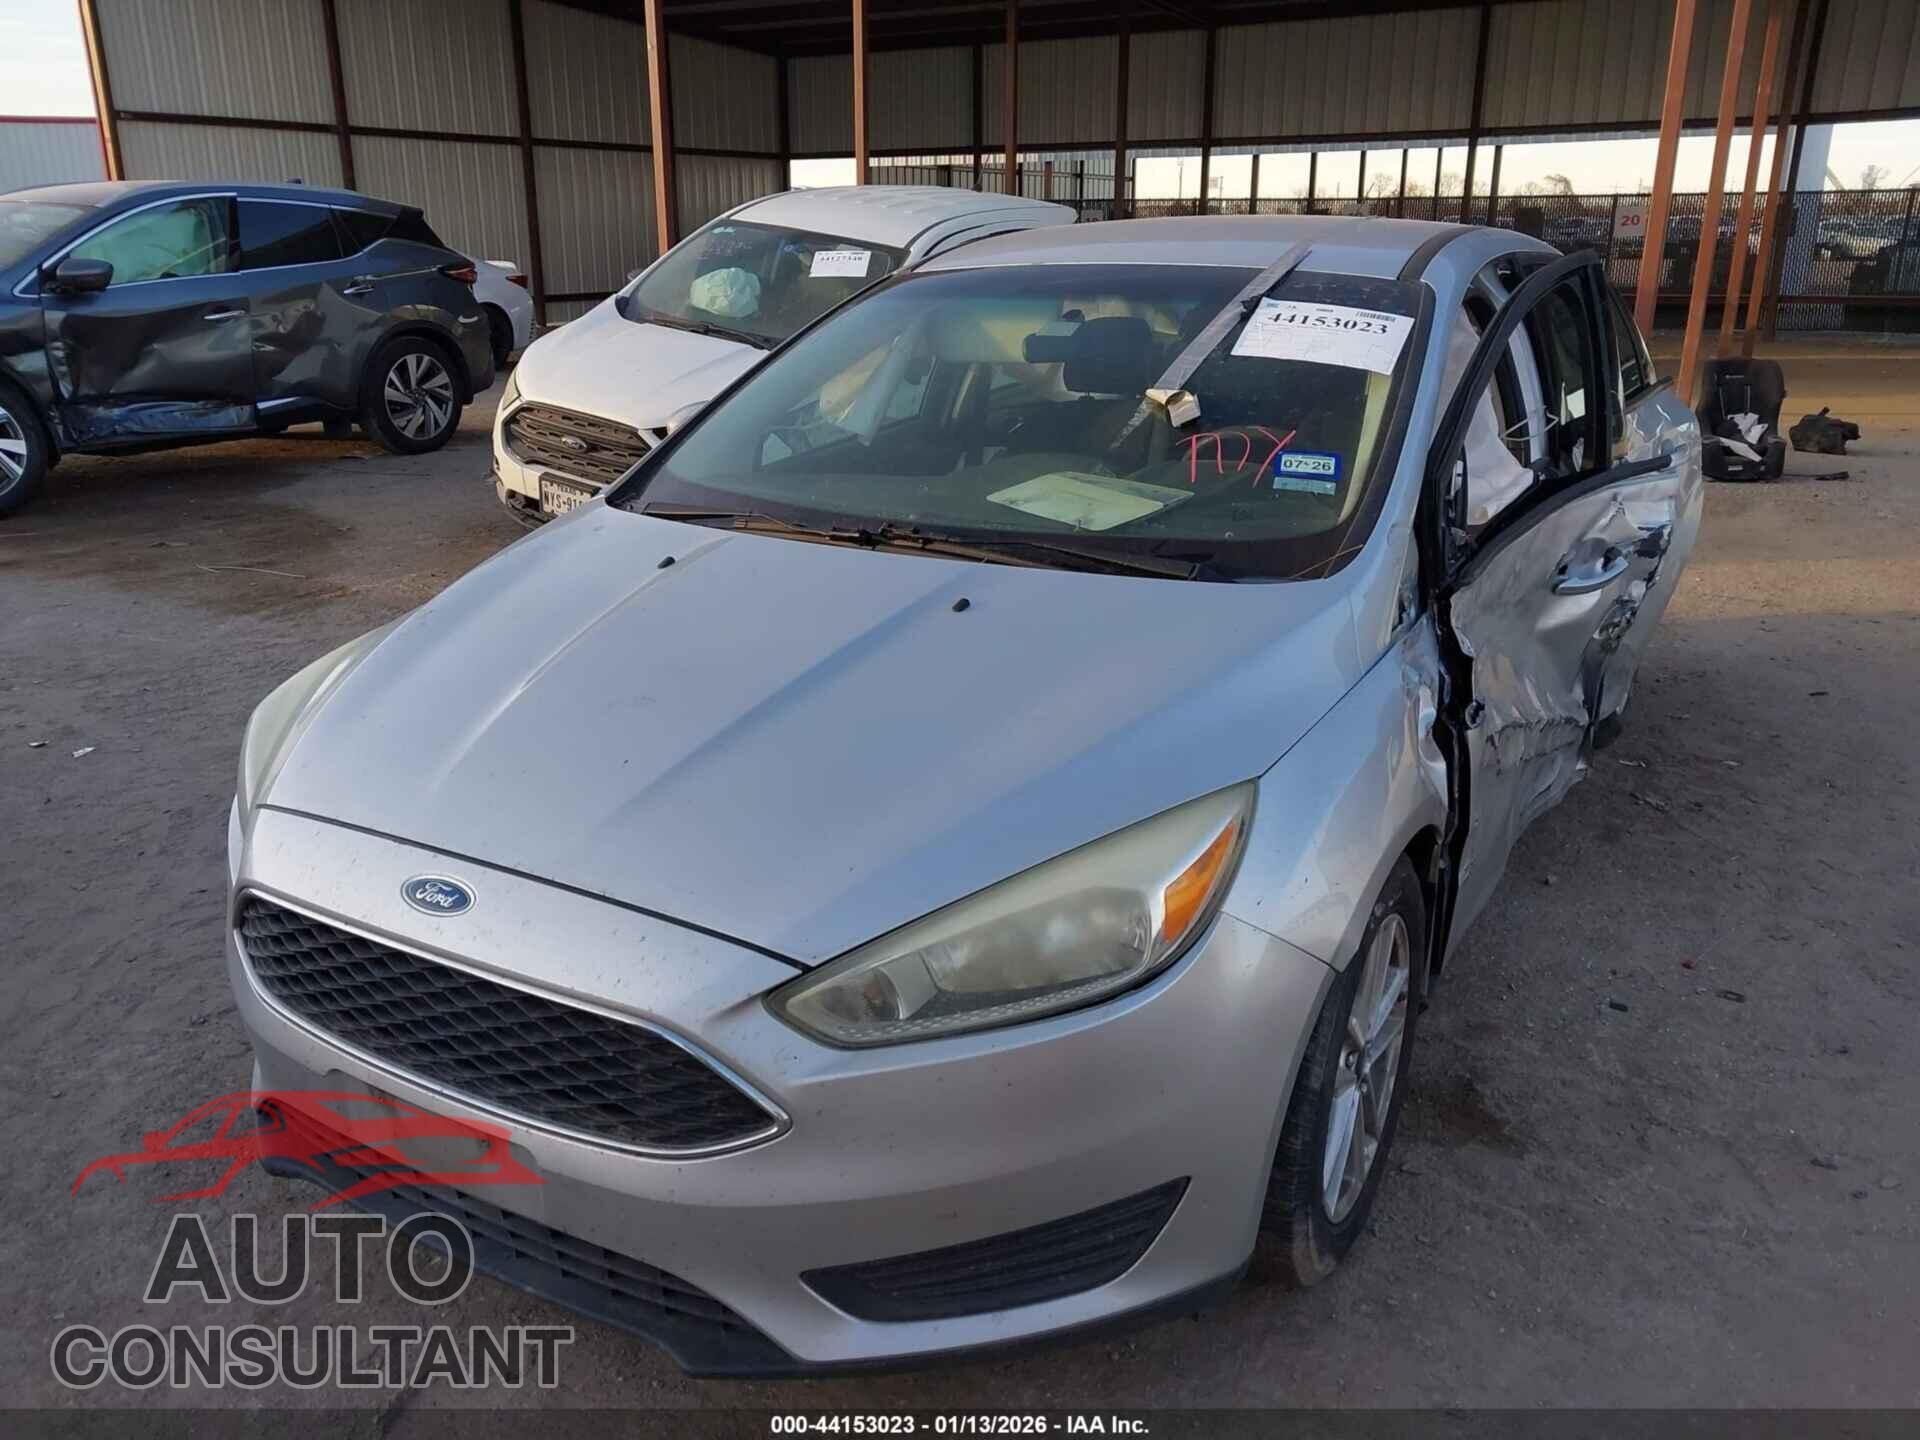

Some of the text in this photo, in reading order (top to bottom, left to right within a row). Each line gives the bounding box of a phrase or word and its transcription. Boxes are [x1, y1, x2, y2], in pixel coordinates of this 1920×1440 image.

[1621, 214, 1640, 226] 20
[1267, 312, 1389, 335] 44153023
[415, 881, 460, 908] Ford
